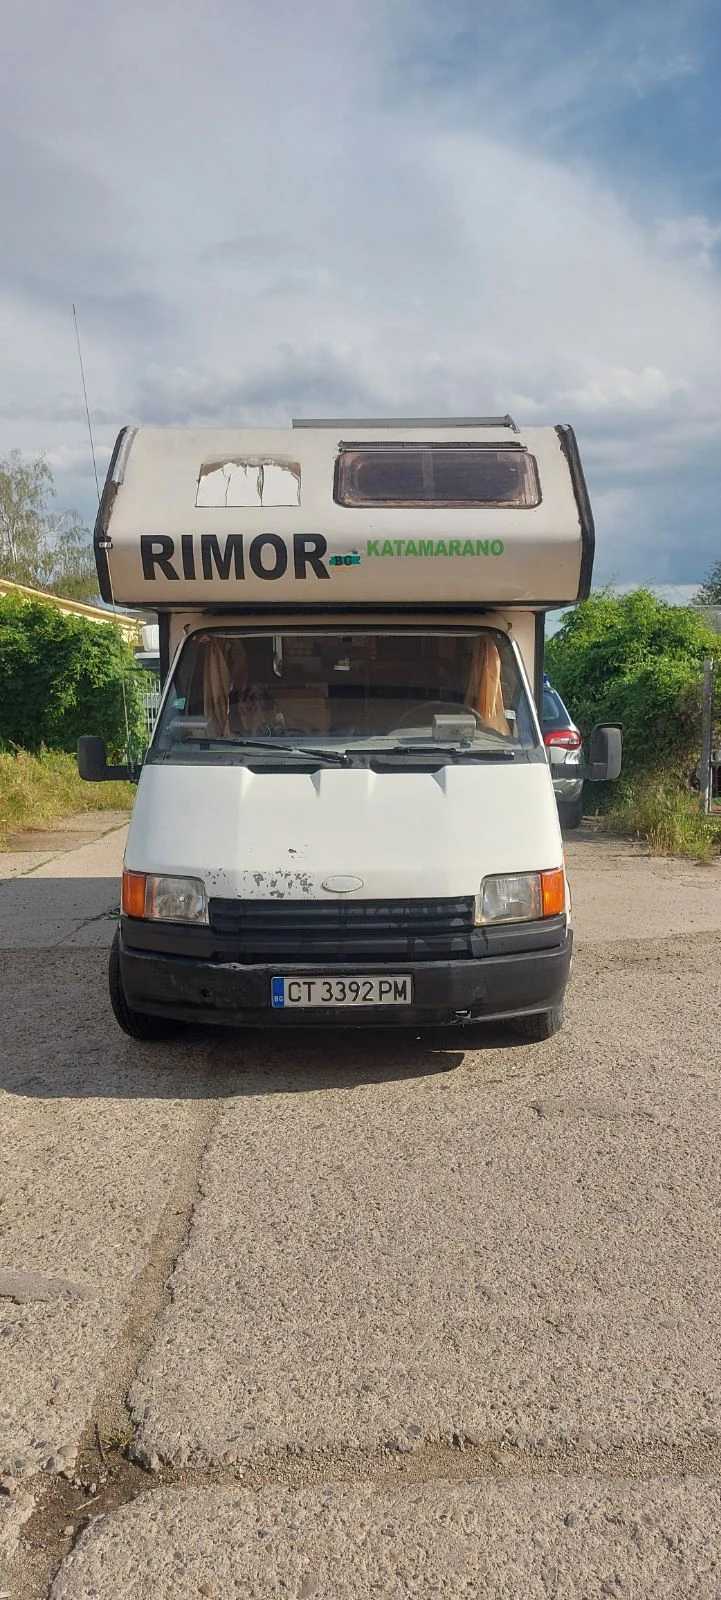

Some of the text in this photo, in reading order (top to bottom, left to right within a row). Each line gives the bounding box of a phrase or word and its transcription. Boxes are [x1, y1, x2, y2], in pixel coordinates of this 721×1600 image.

[140, 533, 331, 580] RIMOR
[366, 539, 505, 557] KATAMARANO
[334, 556, 353, 566] BG
[274, 995, 284, 1003] BG
[288, 980, 407, 1003] CT 3392 PM
